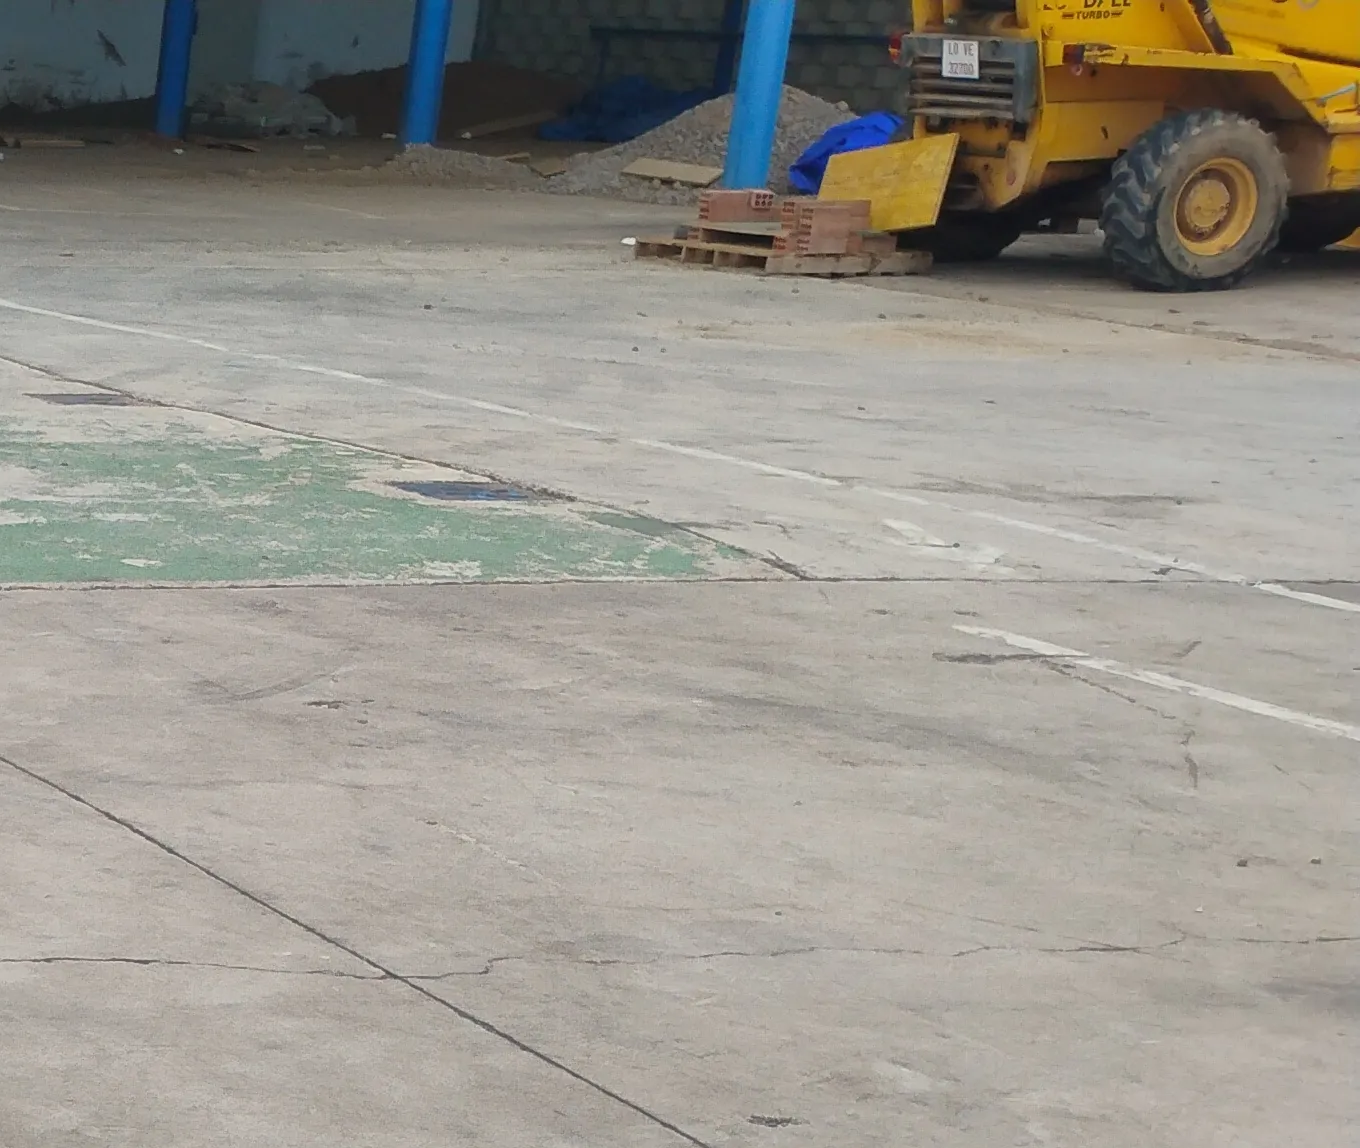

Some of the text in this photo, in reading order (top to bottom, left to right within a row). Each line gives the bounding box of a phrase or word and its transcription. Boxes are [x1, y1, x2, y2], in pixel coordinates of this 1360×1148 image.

[1076, 10, 1111, 20] TURBO
[948, 42, 974, 56] LO VE
